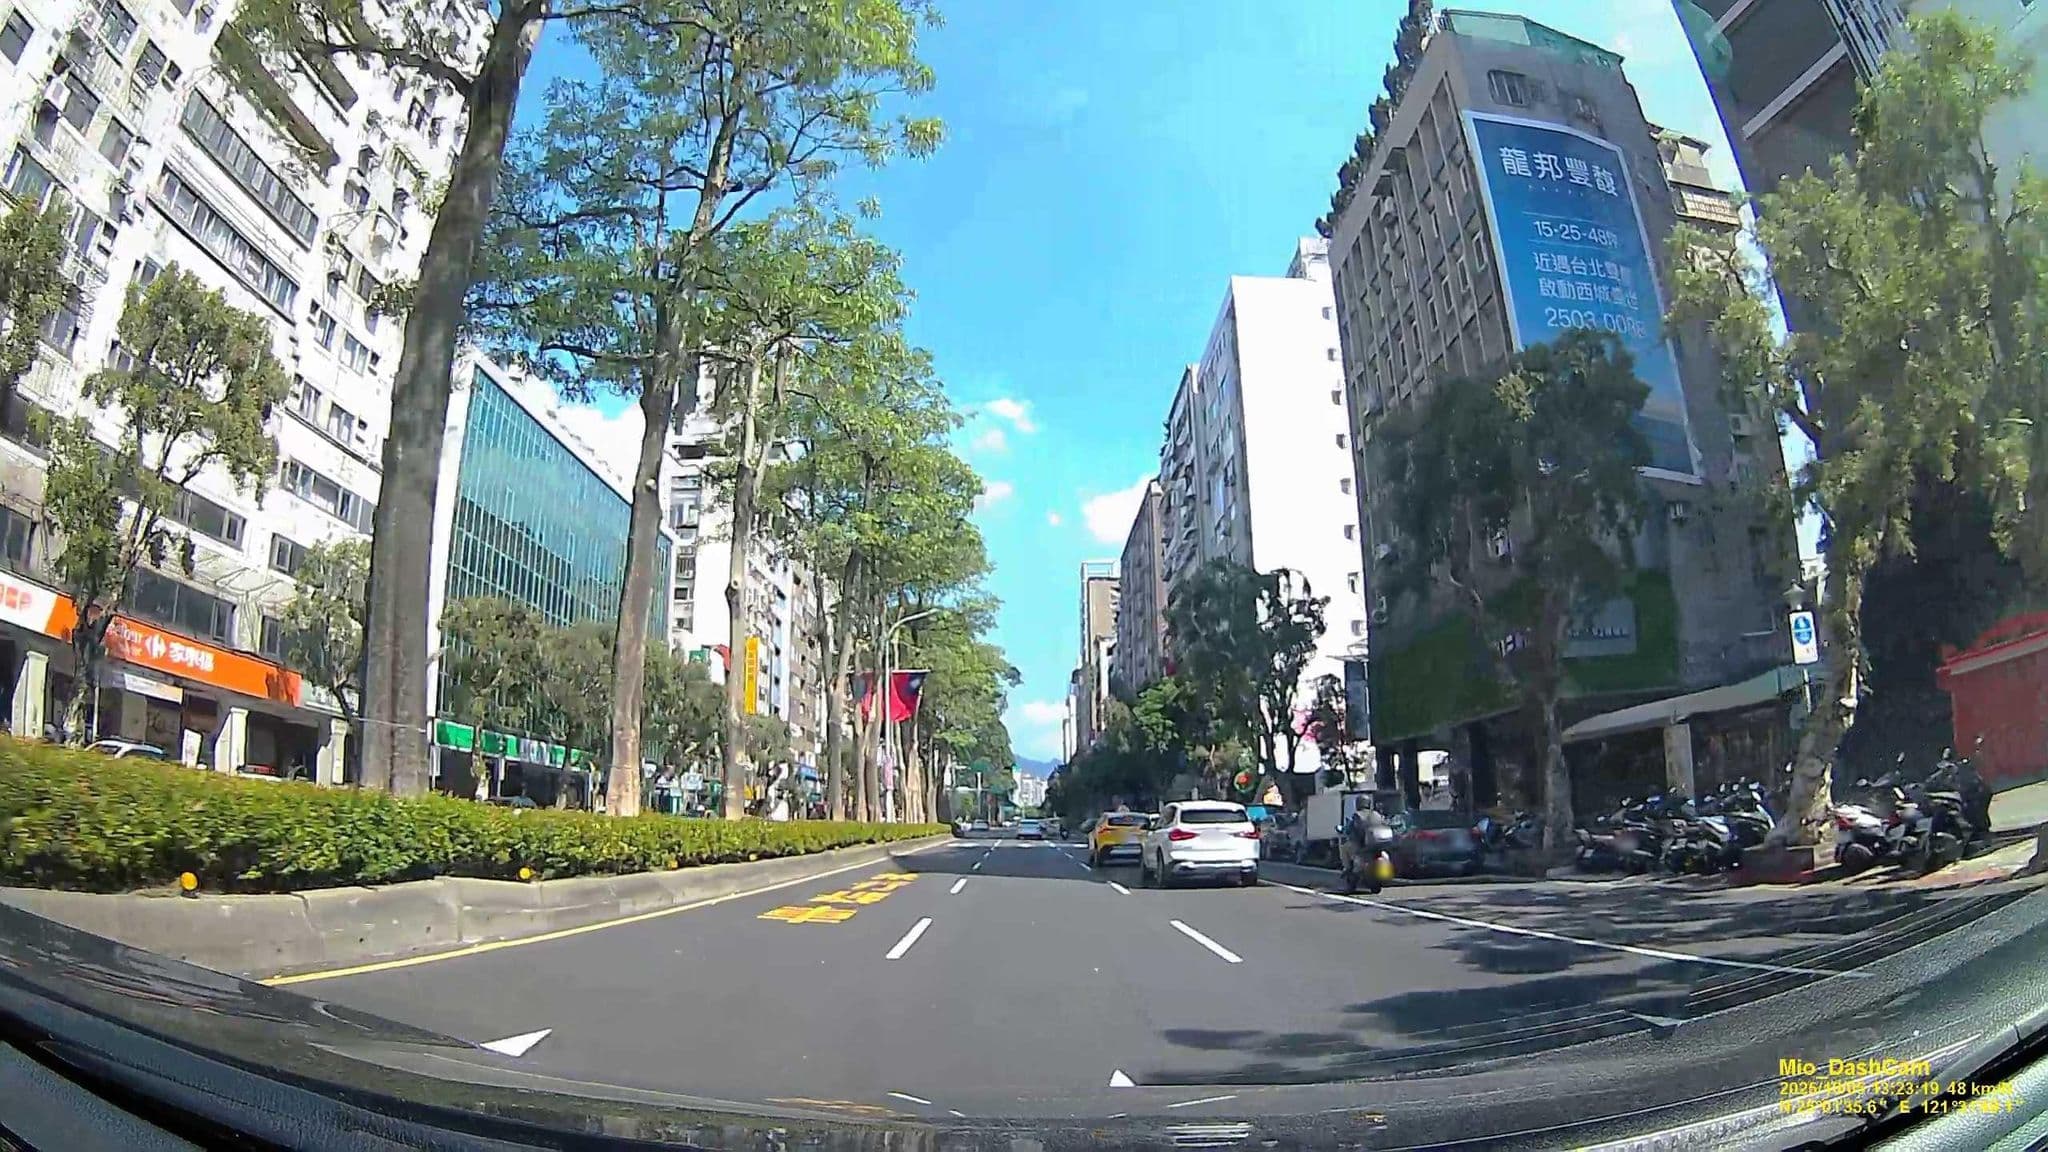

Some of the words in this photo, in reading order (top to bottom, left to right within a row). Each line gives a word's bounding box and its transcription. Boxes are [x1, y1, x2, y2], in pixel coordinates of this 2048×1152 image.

[1499, 146, 1618, 197] 龍邦豐馥
[169, 640, 215, 673] 家樂福
